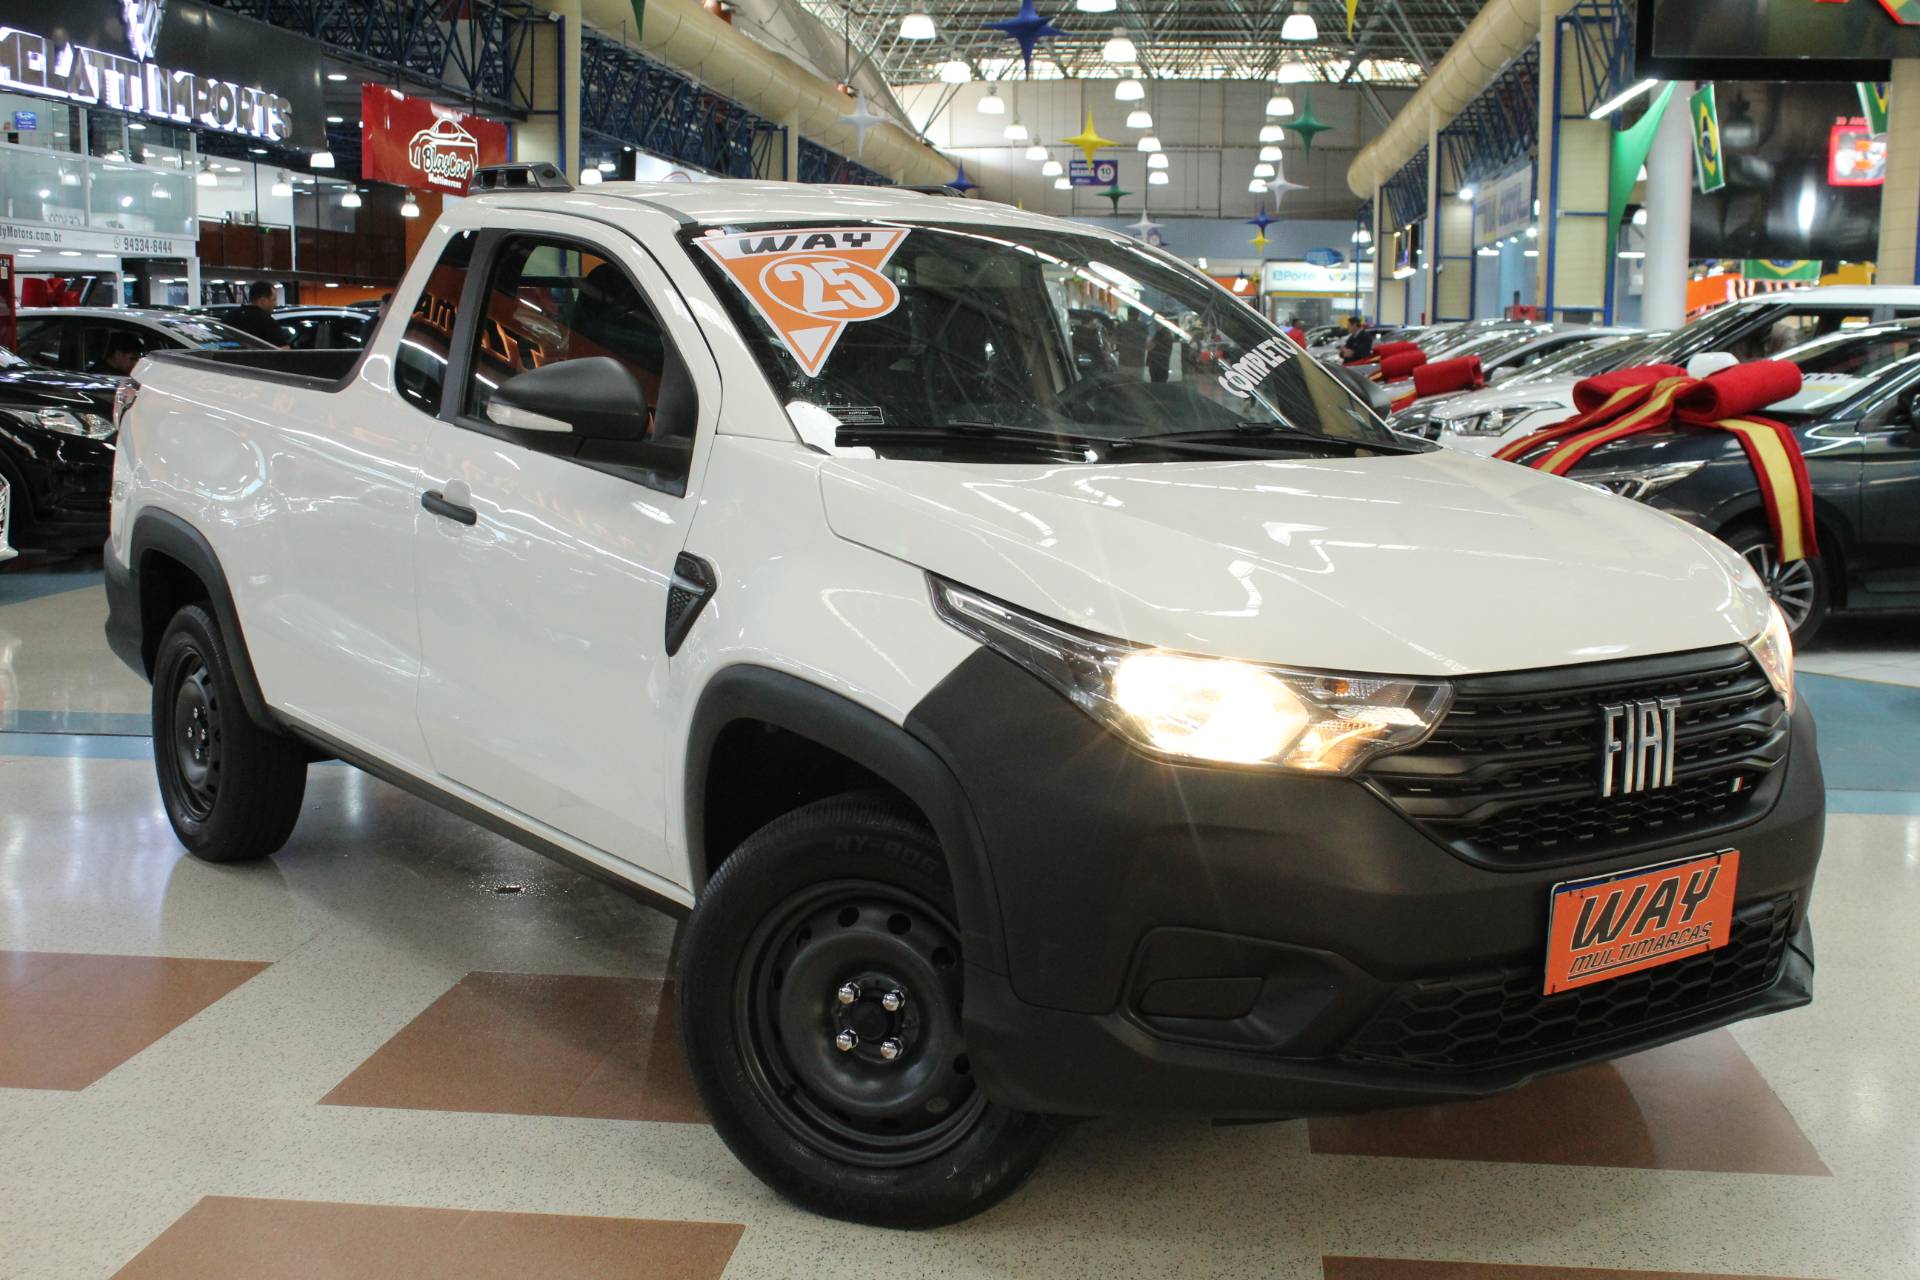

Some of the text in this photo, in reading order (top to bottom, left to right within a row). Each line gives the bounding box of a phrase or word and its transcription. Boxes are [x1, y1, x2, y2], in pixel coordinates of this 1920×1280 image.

[148, 63, 293, 142] IMPORTS
[124, 237, 173, 253] 94334-6444
[738, 232, 872, 255] WAY
[773, 260, 884, 313] 25
[1218, 336, 1298, 398] COMPLETO
[1600, 694, 1681, 797] FIAT
[1570, 864, 1721, 952] WAY
[1567, 921, 1713, 973] MULTIMARCAS
